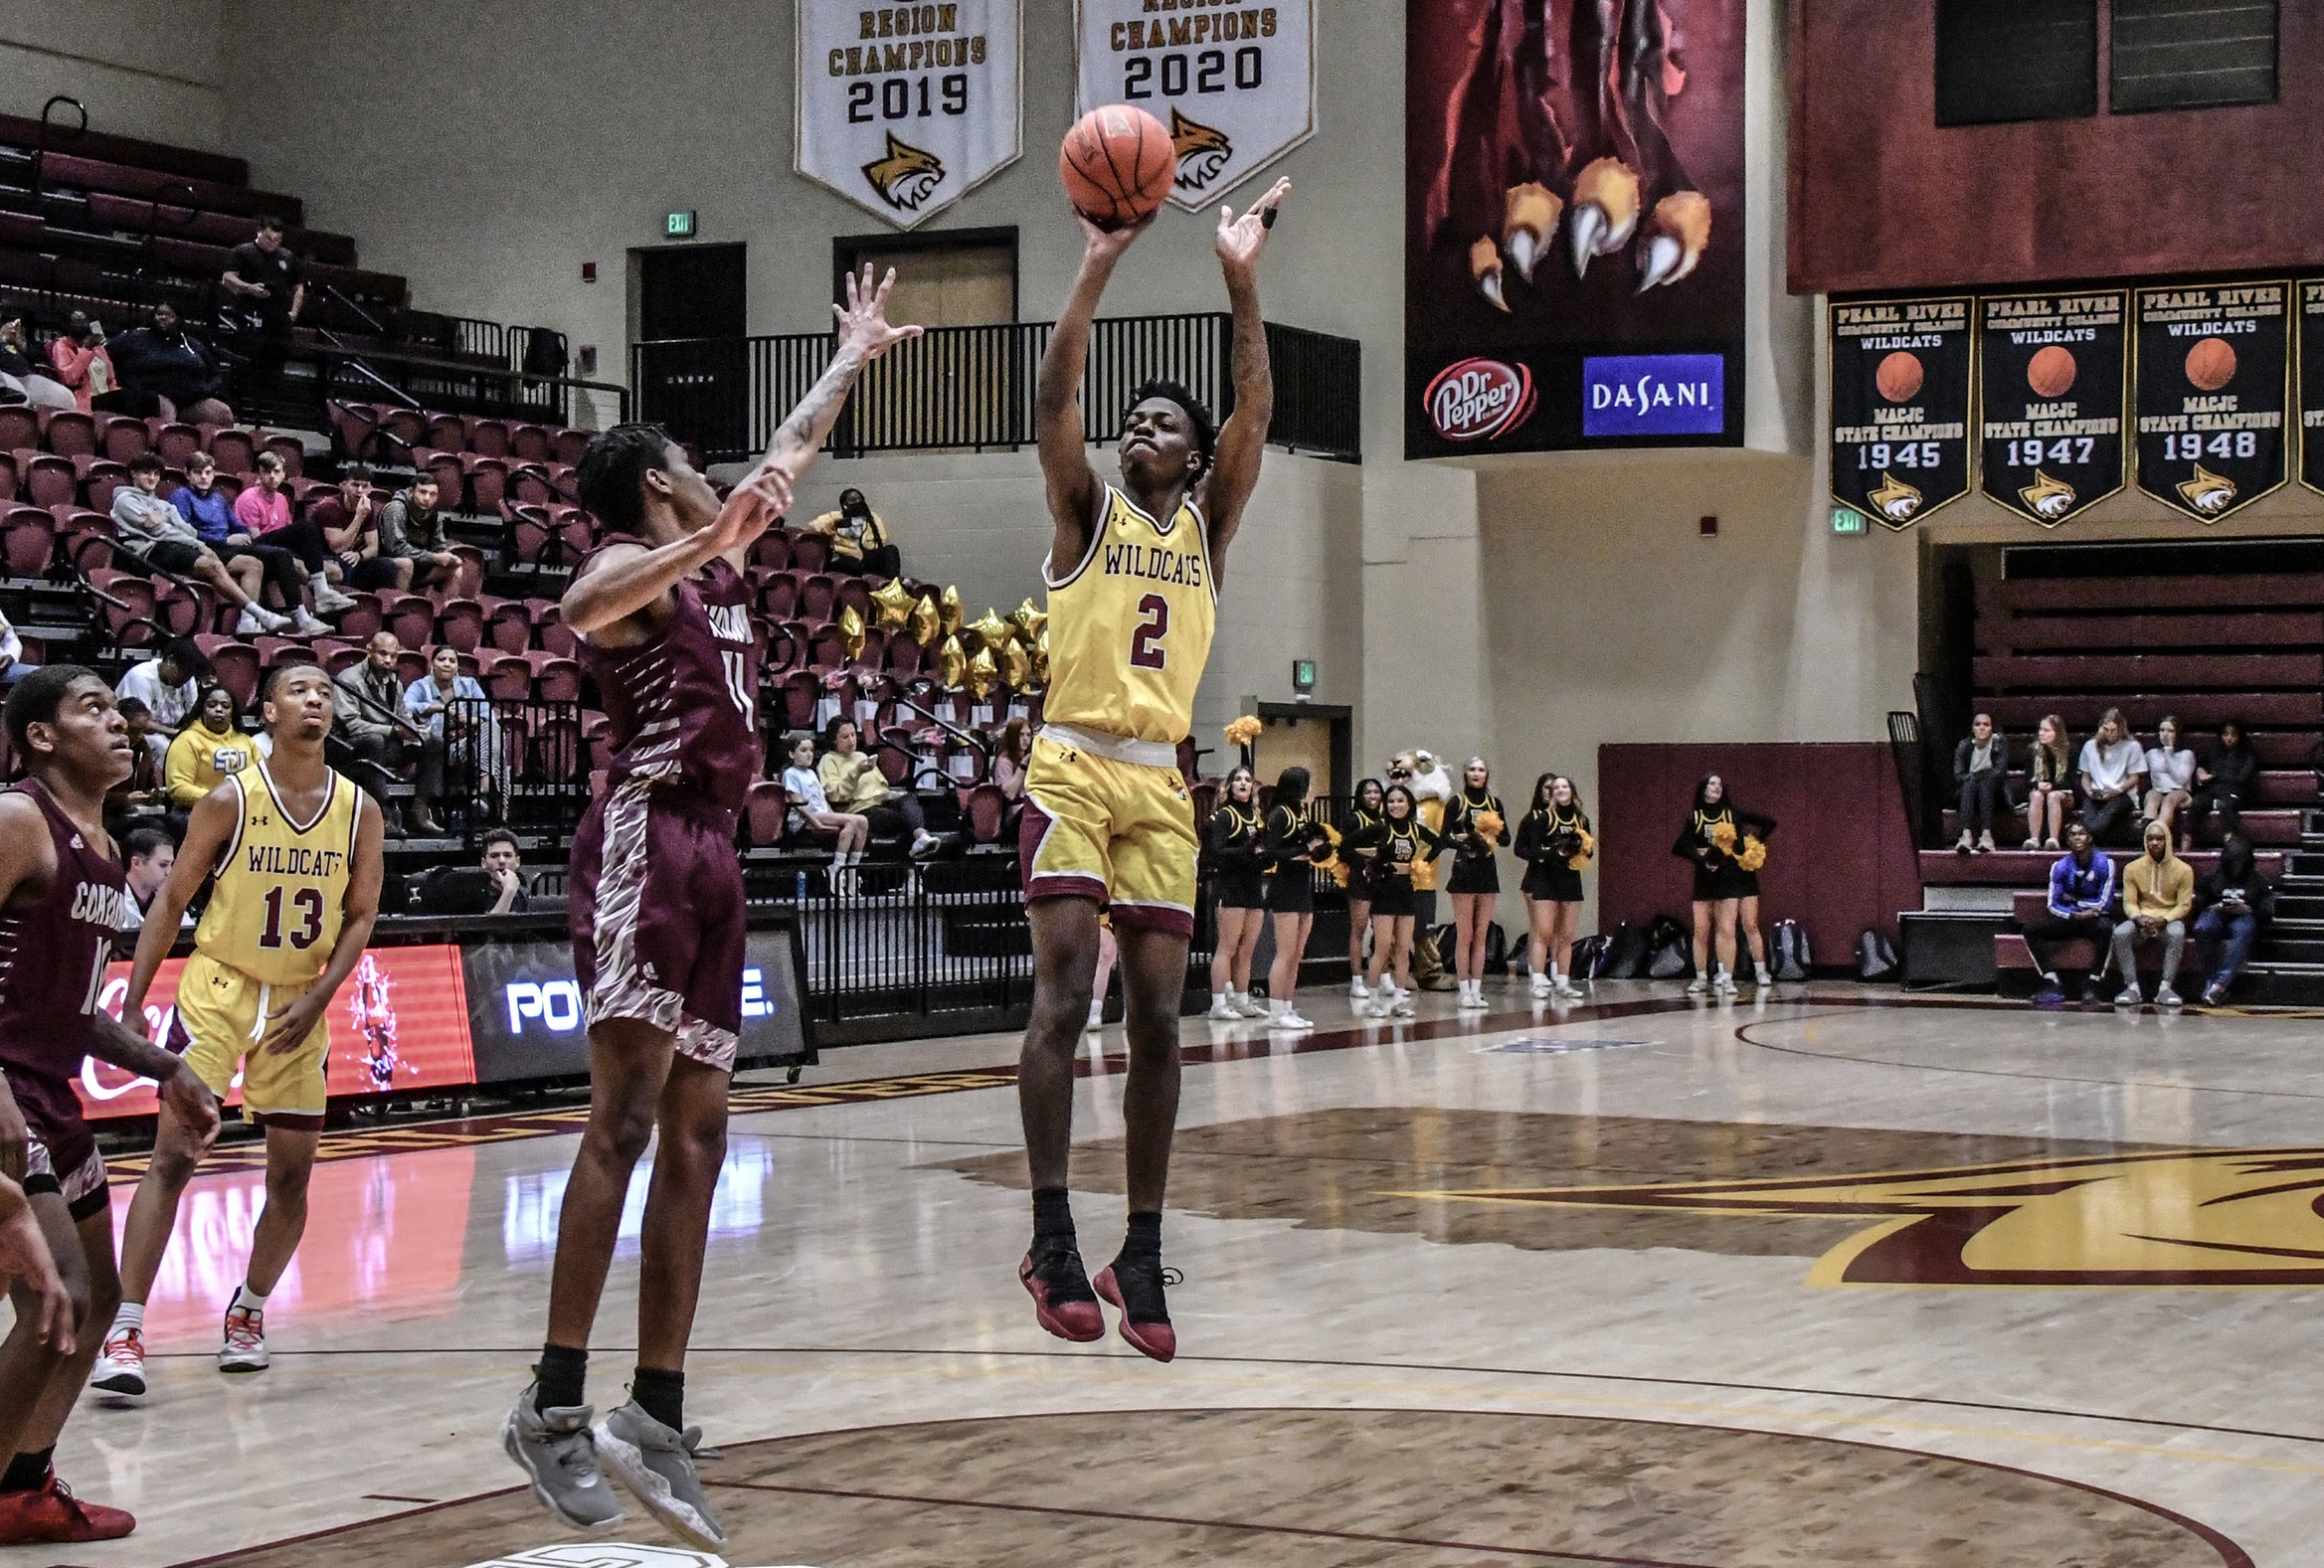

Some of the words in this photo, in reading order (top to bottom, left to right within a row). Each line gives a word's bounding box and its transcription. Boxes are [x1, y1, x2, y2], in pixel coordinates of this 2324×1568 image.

[860, 4, 957, 39] REGION
[1111, 8, 1278, 51] CHAMPIONS
[828, 36, 986, 77] CHAMPIONS
[1125, 46, 1263, 99] 2020
[848, 73, 968, 123] 2019
[1906, 303, 1965, 320] RIVER
[1987, 300, 2053, 317] PEARL
[2058, 296, 2119, 314] RIVER
[2143, 291, 2211, 310] PEARL
[2218, 287, 2281, 305] RIVER
[1861, 334, 1943, 350] WILDCATS
[2011, 328, 2096, 344] WILDCATS
[2167, 319, 2256, 337] WILDCATS
[1462, 371, 1492, 402] Dr
[1592, 376, 1708, 416] DASANI
[1439, 379, 1512, 432] Pepper
[1835, 426, 1879, 443] STATE
[1985, 422, 2032, 438] STATE
[2140, 415, 2188, 434] STATE
[1858, 442, 1940, 470] 1945
[2007, 437, 2094, 466] 1947
[2164, 432, 2256, 460] 1948
[1105, 544, 1201, 587] WILDCATS
[1130, 593, 1168, 670] 2
[260, 886, 323, 950] 13
